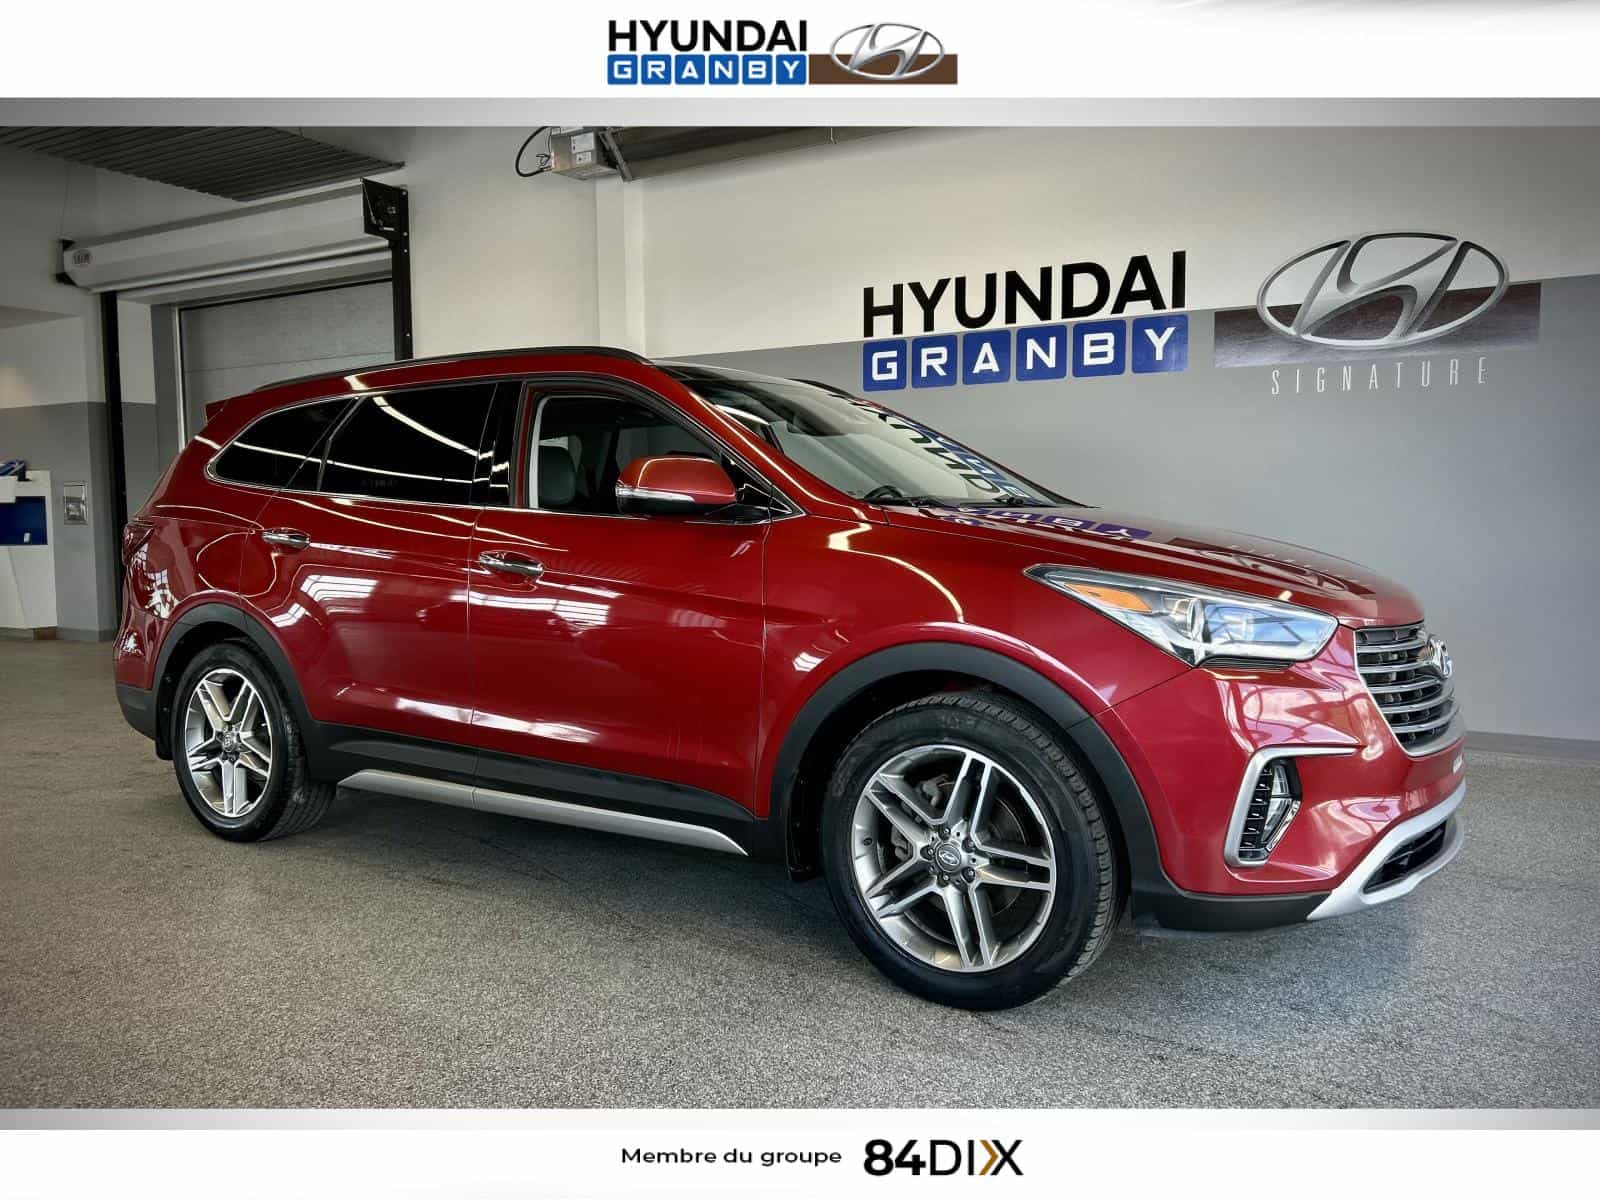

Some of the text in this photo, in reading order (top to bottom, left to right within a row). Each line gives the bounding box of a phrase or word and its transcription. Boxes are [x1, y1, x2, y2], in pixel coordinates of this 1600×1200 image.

[863, 250, 1187, 338] HYUNDAI
[871, 326, 1177, 382] GRANBY
[1271, 356, 1488, 395] SIGNATURE
